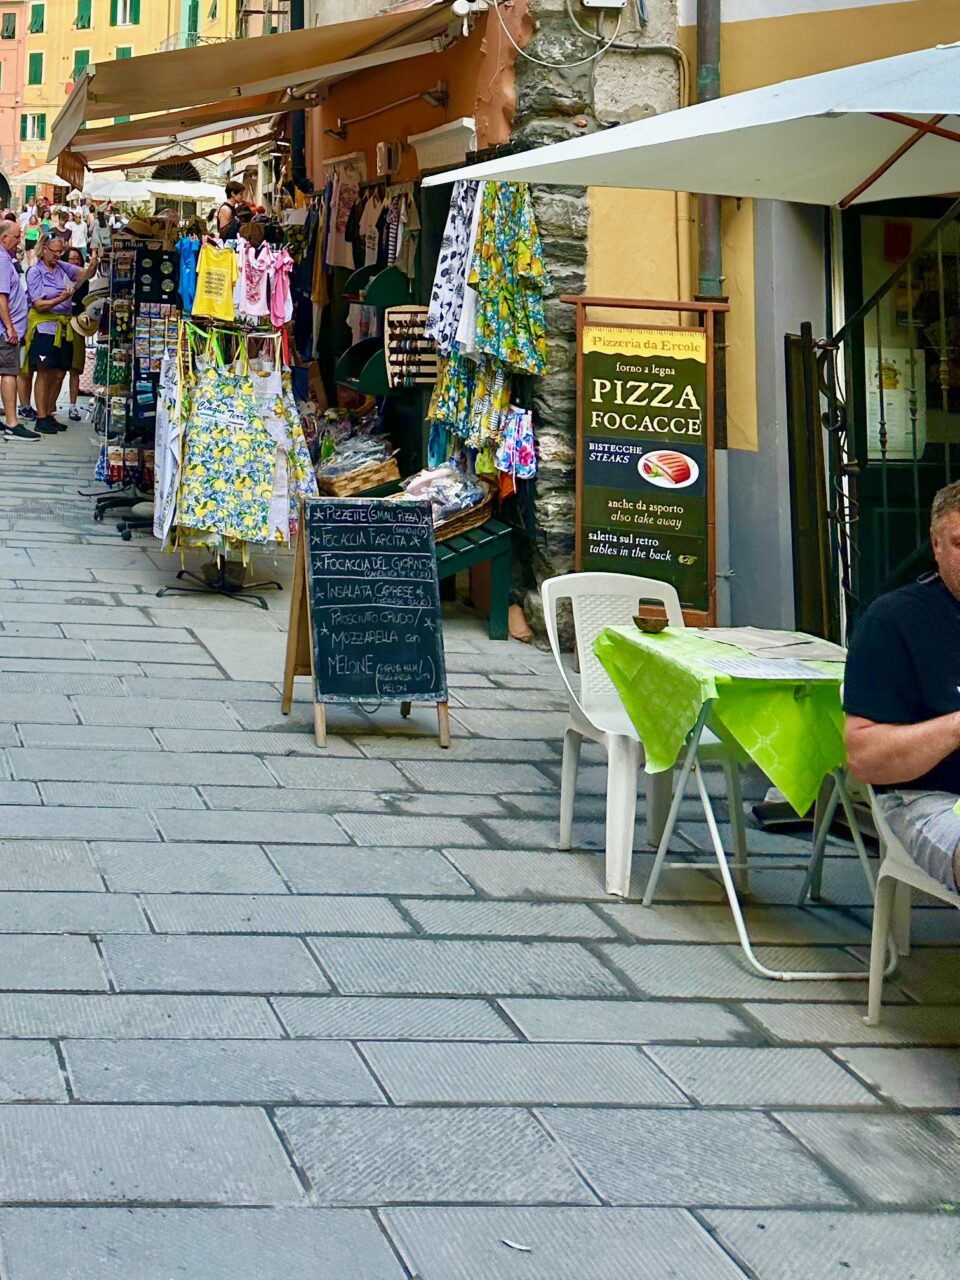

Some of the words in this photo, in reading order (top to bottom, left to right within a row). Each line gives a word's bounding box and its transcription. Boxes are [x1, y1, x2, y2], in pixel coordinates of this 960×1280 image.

[592, 336, 641, 350] Pizzeria
[643, 340, 658, 350] da
[661, 340, 701, 352] Ercole
[616, 362, 642, 373] forno
[652, 364, 675, 377] legna
[591, 378, 701, 410] PIZZA
[197, 401, 225, 414] Cinque
[228, 410, 249, 422] Terre
[591, 411, 702, 436] FOCACCE
[589, 442, 643, 454] BISTECCHE
[589, 452, 630, 464] STEAKS
[324, 505, 367, 521] PIZZETTE
[608, 499, 634, 510] anche
[636, 500, 647, 511] da
[649, 503, 684, 515] asporto
[611, 511, 631, 522] also
[634, 513, 654, 524] take
[656, 516, 682, 530] away
[321, 526, 366, 547] FOCACCIA
[588, 531, 617, 543] saletta
[620, 534, 633, 544] sul
[635, 537, 659, 547] retro
[589, 543, 617, 555] tables
[620, 546, 629, 556] in
[631, 547, 646, 558] the
[649, 549, 672, 561] back
[321, 554, 369, 570] FOCACCIA
[371, 556, 390, 570] DEL
[327, 582, 372, 599] INSALATA
[331, 631, 398, 650] MOZZARELLA
[328, 654, 374, 676] MELONE
